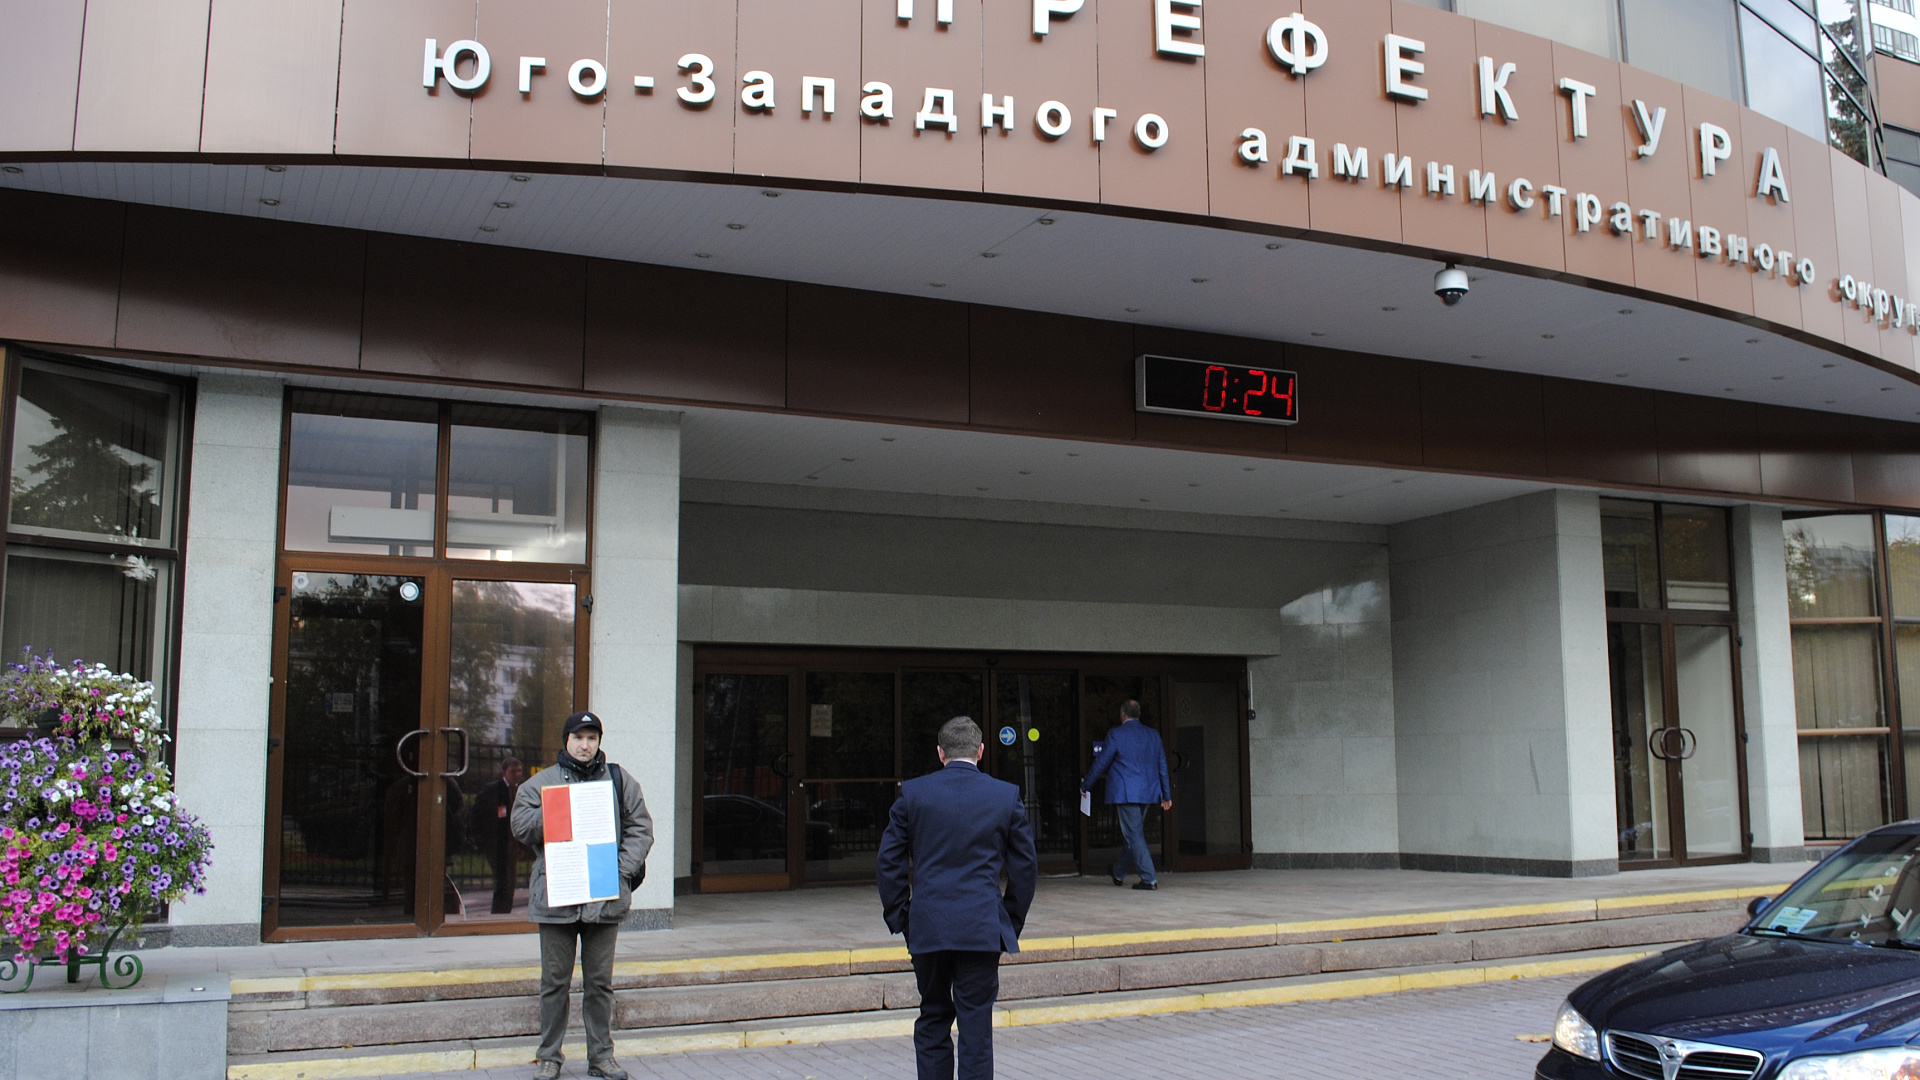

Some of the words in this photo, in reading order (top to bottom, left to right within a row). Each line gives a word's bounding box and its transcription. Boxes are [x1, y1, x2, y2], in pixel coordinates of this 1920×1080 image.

[422, 38, 1170, 150] Юго-Западного
[1238, 127, 1815, 285] административного
[1203, 365, 1293, 416] 0:24
